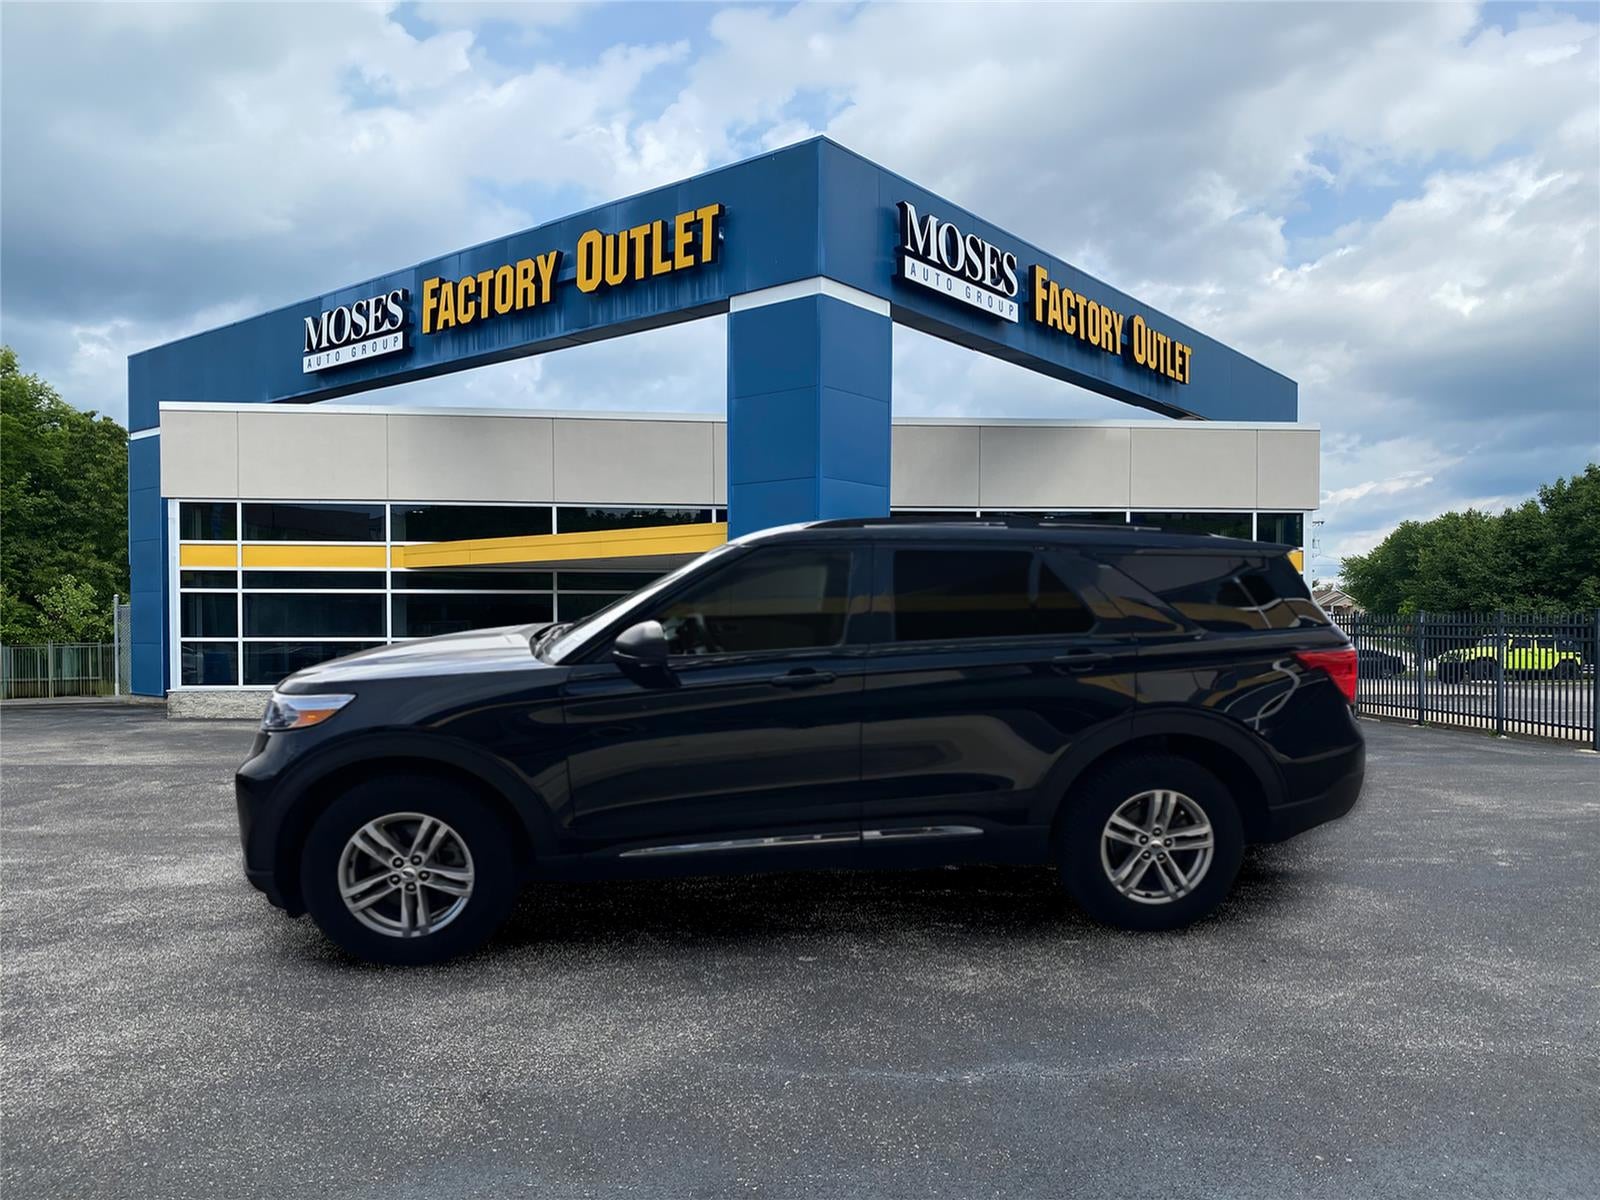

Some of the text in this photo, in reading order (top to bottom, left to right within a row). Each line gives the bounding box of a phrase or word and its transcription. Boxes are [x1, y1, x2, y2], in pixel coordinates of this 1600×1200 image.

[422, 203, 720, 334] FACTORY OUTLET
[904, 201, 1019, 297] MOSES
[910, 262, 1015, 315] AUTO GROUP
[303, 289, 403, 353] MOSES
[307, 335, 400, 369] AUTO GROUP
[1034, 264, 1192, 385] FACTORY OUTLET
